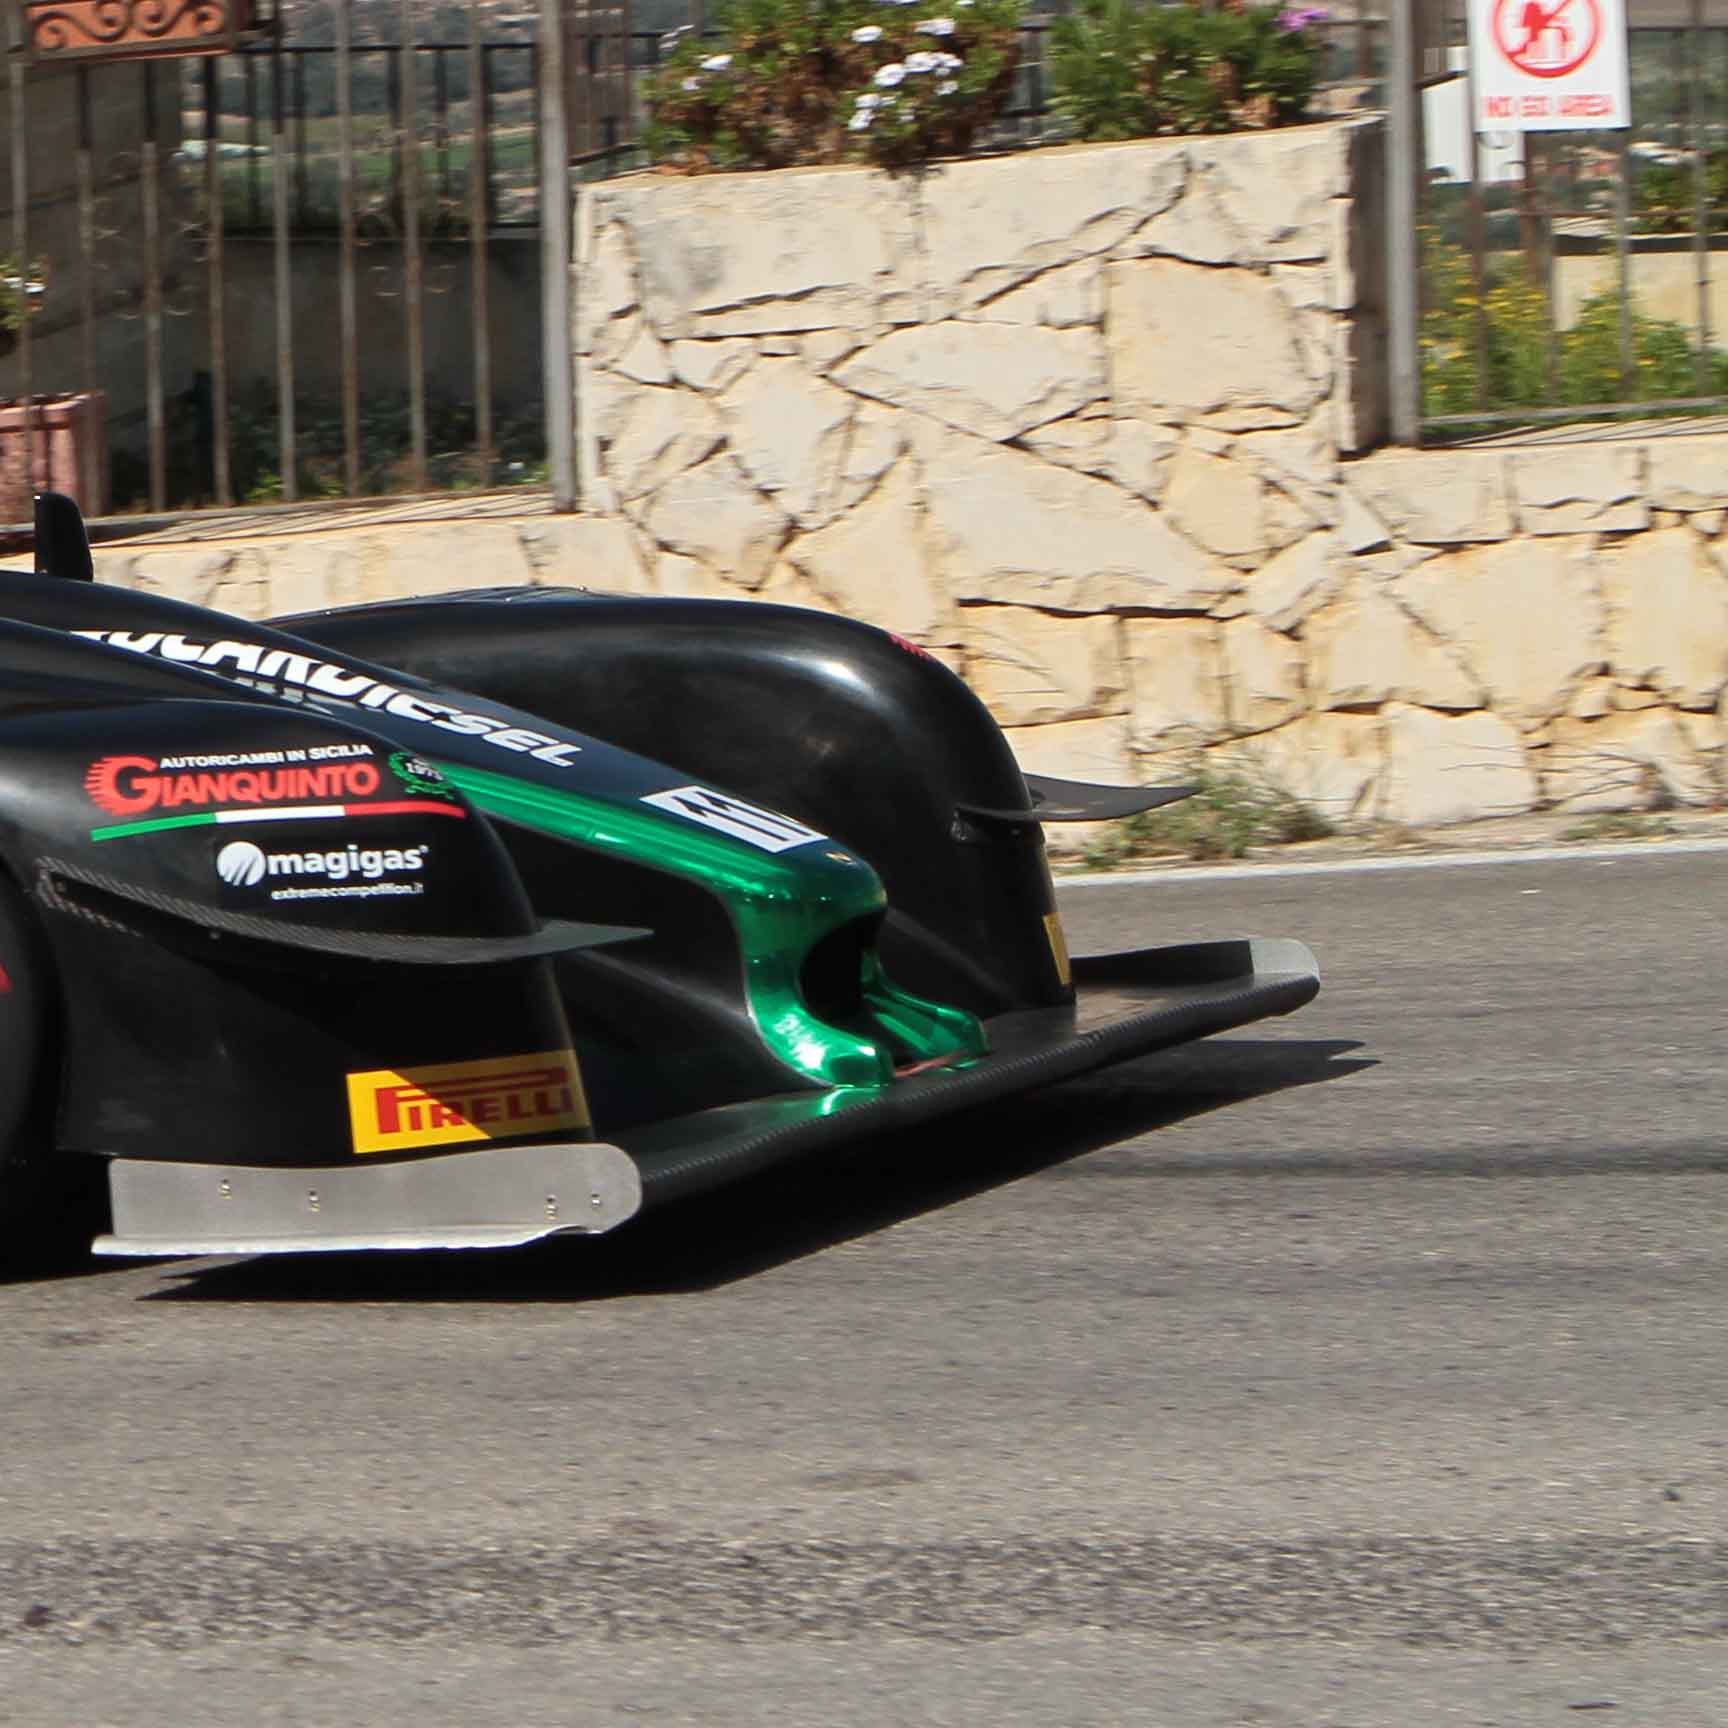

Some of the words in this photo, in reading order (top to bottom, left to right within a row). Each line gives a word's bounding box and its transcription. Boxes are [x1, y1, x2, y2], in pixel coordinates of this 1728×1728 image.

[84, 755, 380, 816] GIANQUINTO
[159, 749, 285, 769] AUTORICAMBI
[287, 747, 307, 763] IN
[309, 744, 374, 761] SICILIA
[374, 1066, 577, 1135] PIRELLI
